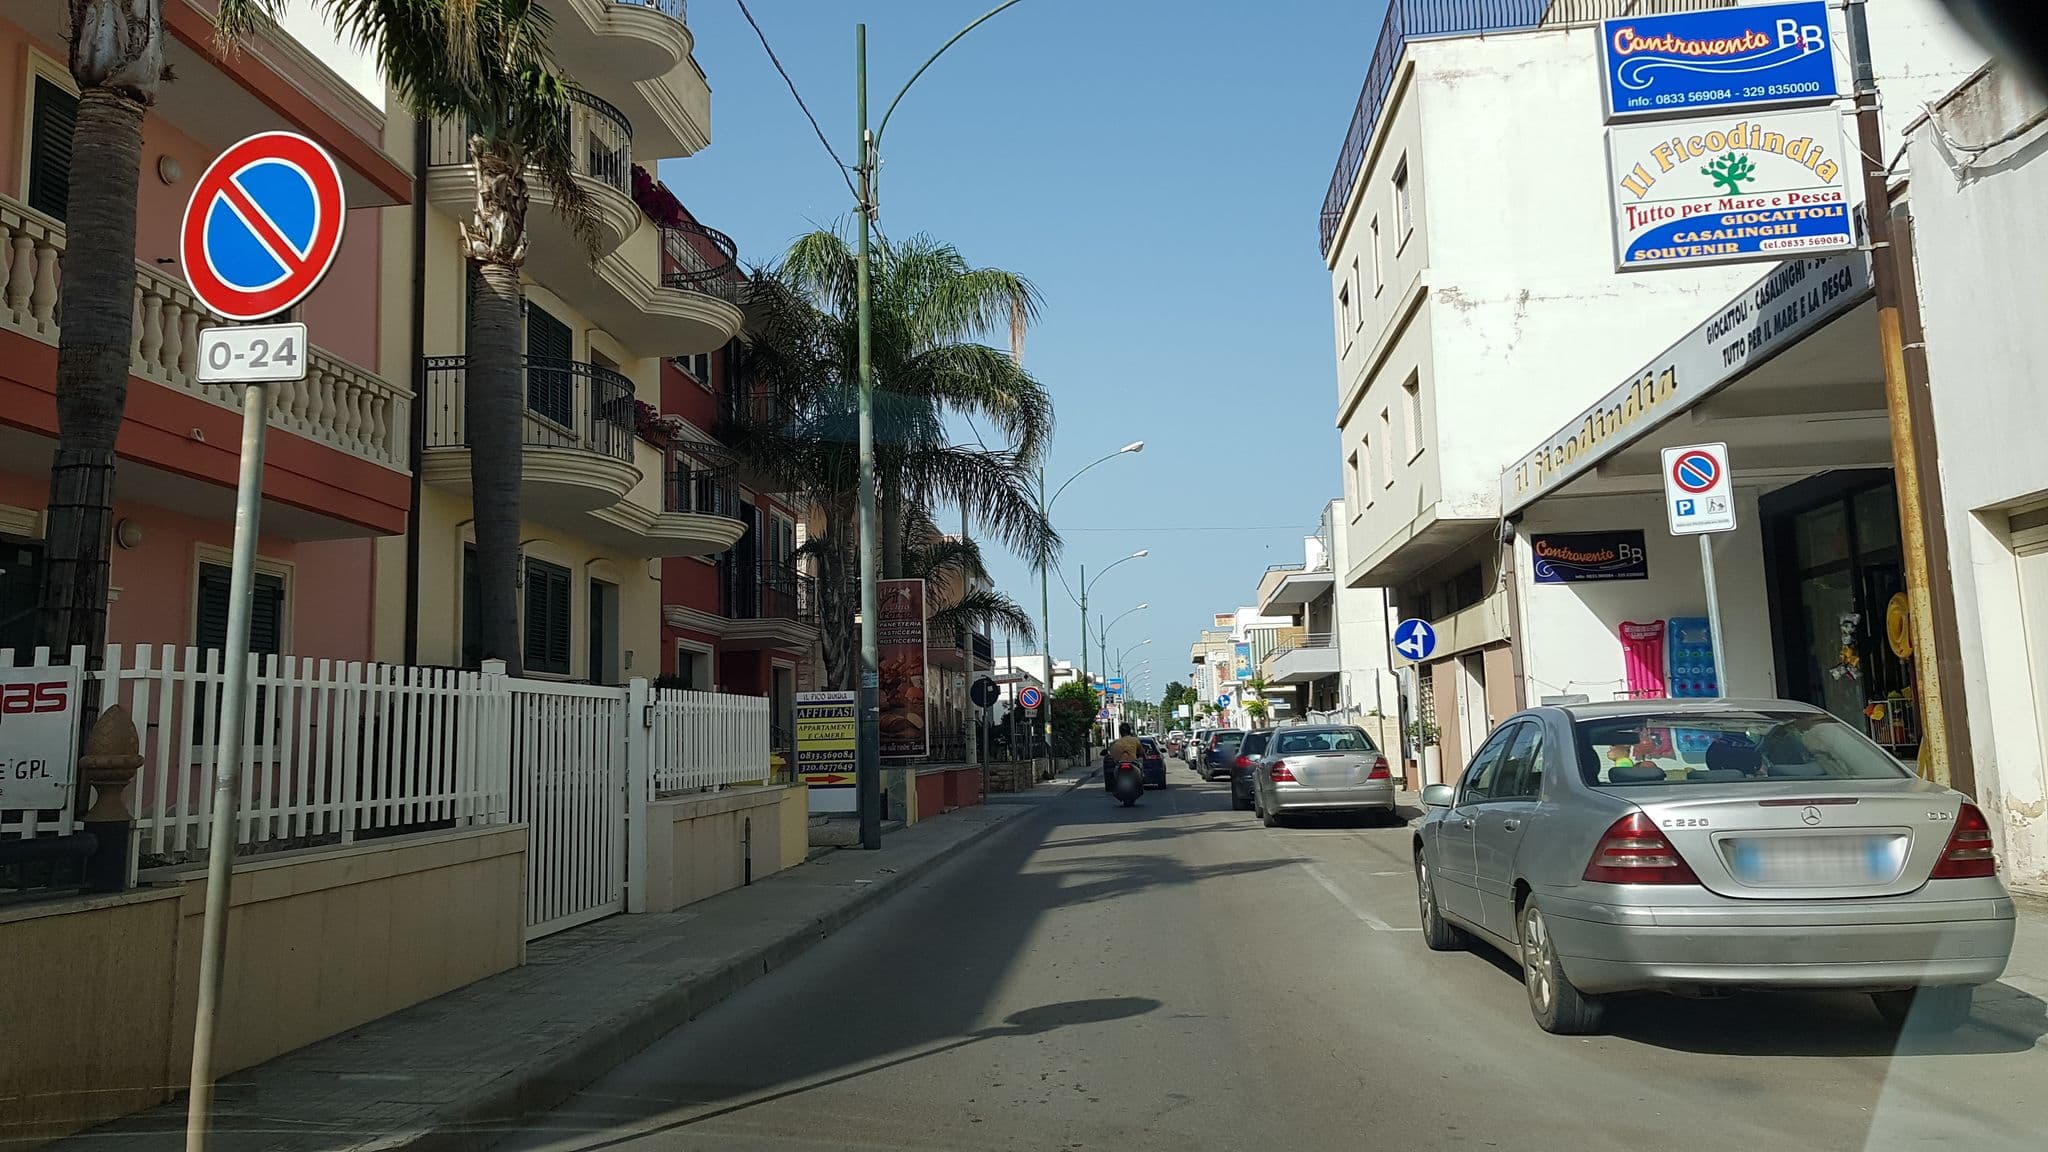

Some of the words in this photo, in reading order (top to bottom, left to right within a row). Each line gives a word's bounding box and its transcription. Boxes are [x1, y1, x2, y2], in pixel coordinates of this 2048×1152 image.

[1613, 27, 1770, 56] Controvento
[1628, 96, 1653, 107] info:
[1655, 93, 1685, 105] 0833
[1688, 89, 1731, 101] 569084
[1743, 87, 1765, 98] 329
[1768, 81, 1820, 95] 8350000
[1620, 162, 1655, 199] Il
[1651, 121, 1838, 183] Ficodindia
[1625, 204, 1676, 232] Tutto
[1681, 202, 1712, 217] per
[1718, 197, 1766, 211] Mare
[1771, 196, 1783, 206] e
[1788, 191, 1842, 205] Pesca
[1720, 206, 1844, 226] GIOCATTOLI
[1672, 223, 1798, 243] CASALINGHI
[1808, 236, 1845, 246] 569084
[1633, 242, 1740, 261] SOUVENIR
[1706, 299, 1748, 345] GIOCATTOLI
[1755, 259, 1806, 311] CASALINGHI
[1722, 337, 1746, 368] TUTTO
[1747, 326, 1763, 352] PER
[1764, 320, 1772, 342] IL
[1774, 300, 1799, 336] MARE
[1800, 295, 1806, 319] E
[1808, 287, 1820, 314] LA
[1822, 265, 1853, 304] PESCA
[208, 337, 298, 371] 0-24
[1513, 460, 1529, 496] il
[1679, 501, 1691, 515] P
[1536, 540, 1615, 562] Controvento
[0, 681, 68, 715] as
[798, 707, 854, 718] AFFITTASI
[799, 723, 854, 732] APPARTAMENTI
[814, 731, 845, 739] CAMERE
[800, 750, 854, 761] 0833.569084
[1662, 818, 1673, 828] C
[1675, 818, 1710, 827] 220
